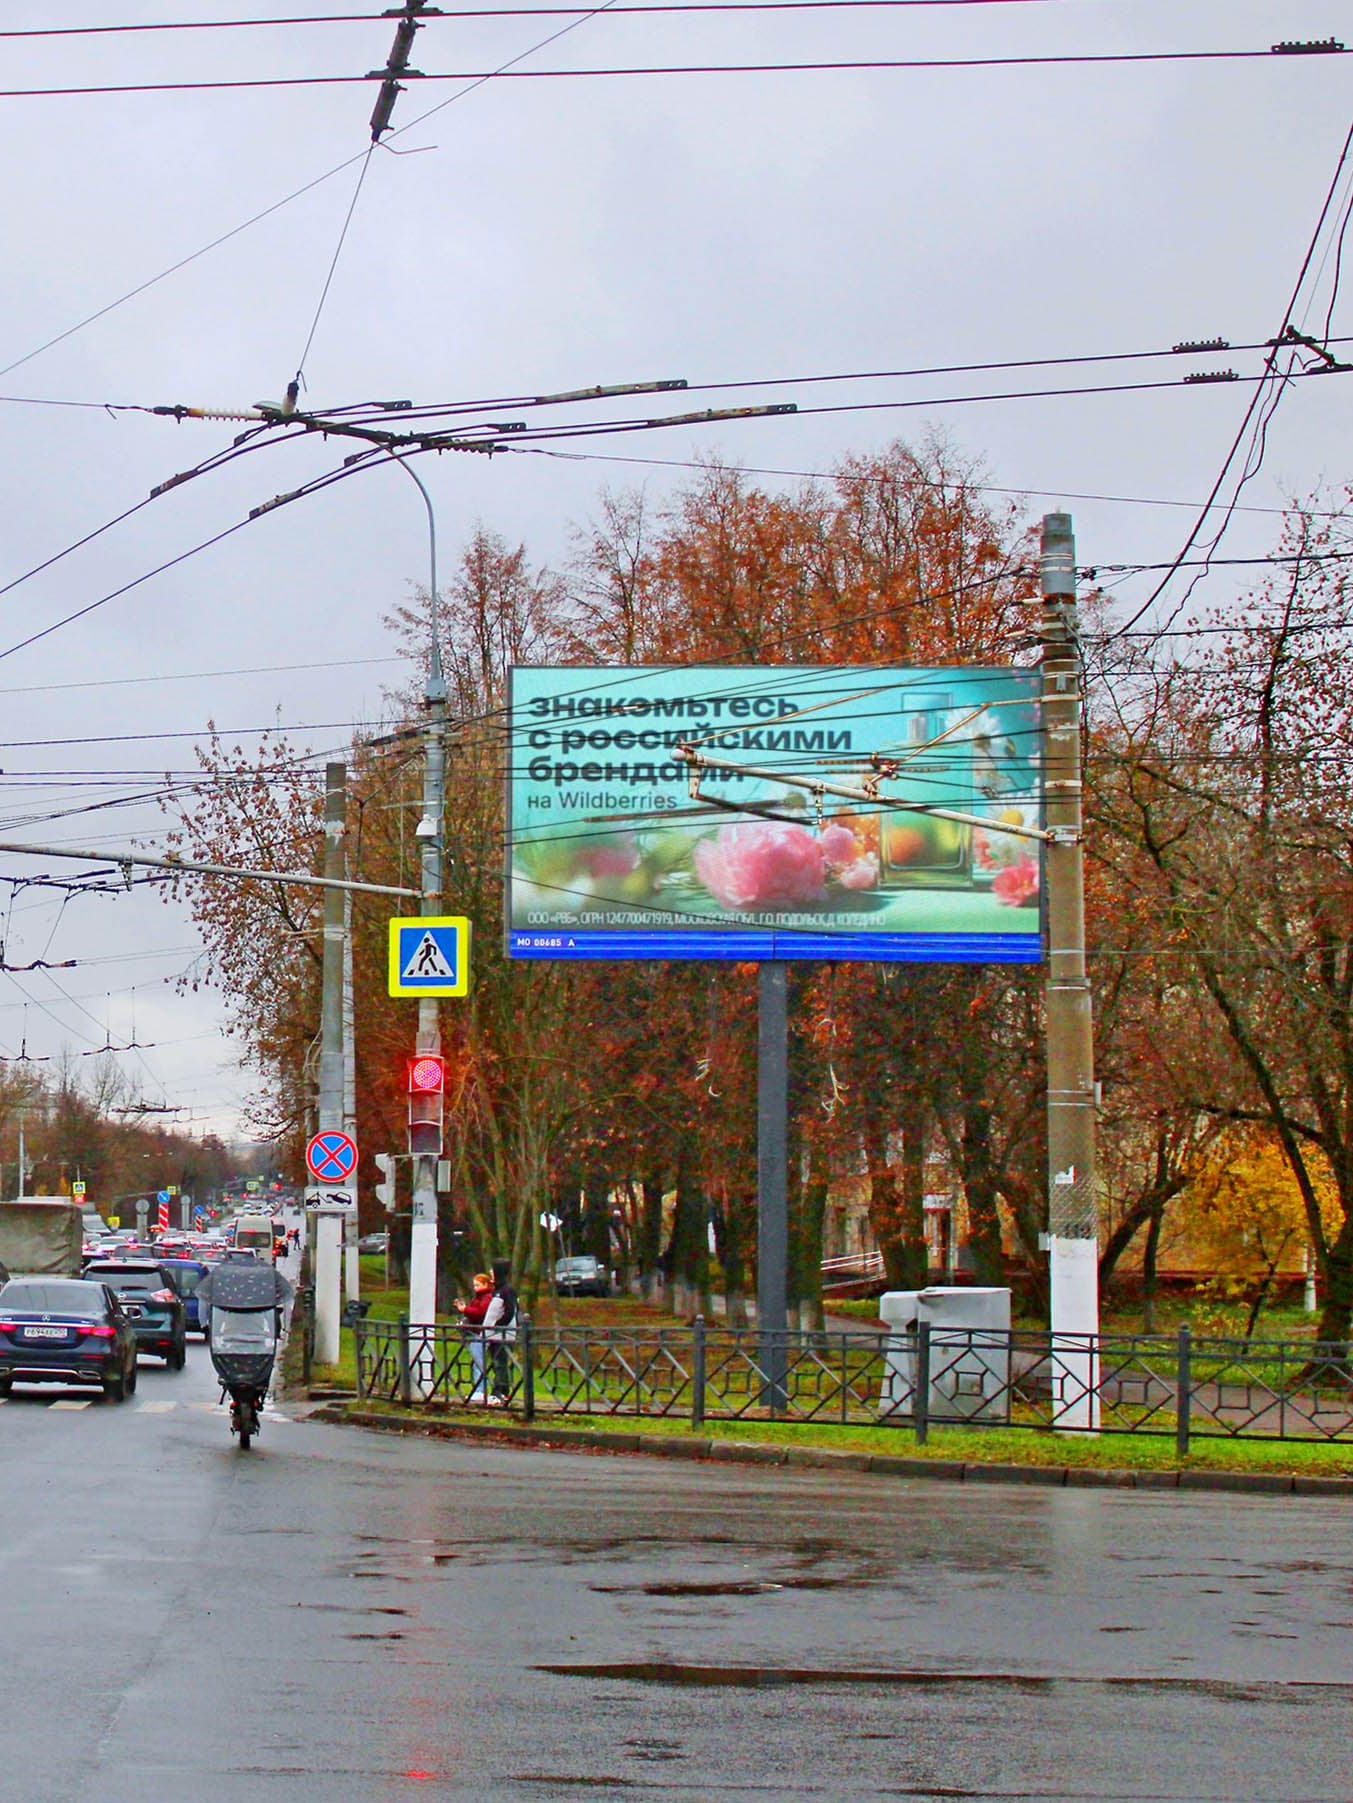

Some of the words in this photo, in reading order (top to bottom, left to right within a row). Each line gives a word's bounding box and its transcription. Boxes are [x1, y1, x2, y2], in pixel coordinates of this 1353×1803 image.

[528, 697, 799, 718] знакомьтесь
[528, 729, 552, 750] с
[561, 722, 852, 754] российскими
[527, 794, 552, 809] на
[558, 791, 678, 809] Wildberries
[527, 911, 549, 924] ООО
[517, 938, 531, 947] МО
